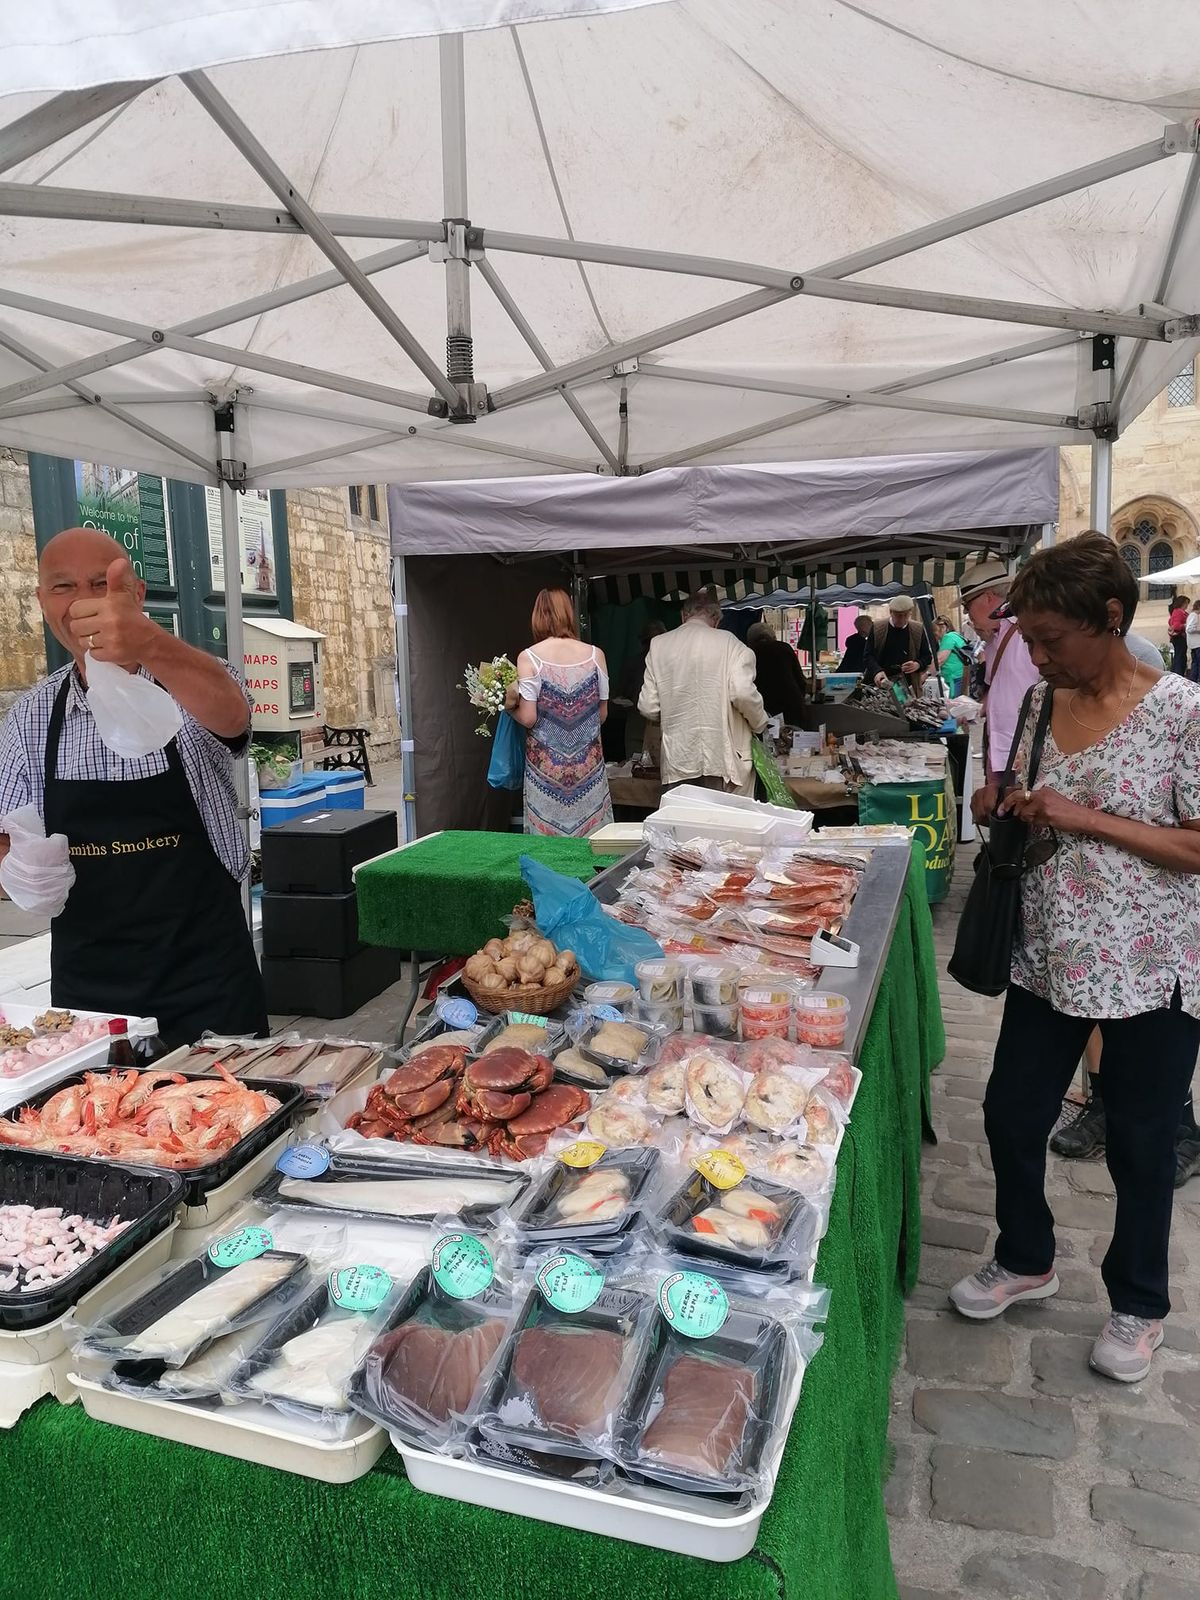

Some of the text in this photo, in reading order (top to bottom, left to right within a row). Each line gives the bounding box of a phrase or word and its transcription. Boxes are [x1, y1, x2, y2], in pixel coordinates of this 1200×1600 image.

[80, 504, 139, 524] Welcome to the
[123, 527, 139, 550] of
[243, 654, 278, 666] MAPS
[250, 703, 279, 715] APS
[68, 834, 181, 856] miths Smokery
[680, 1289, 692, 1319] FRESH
[687, 1293, 700, 1320] TUNA
